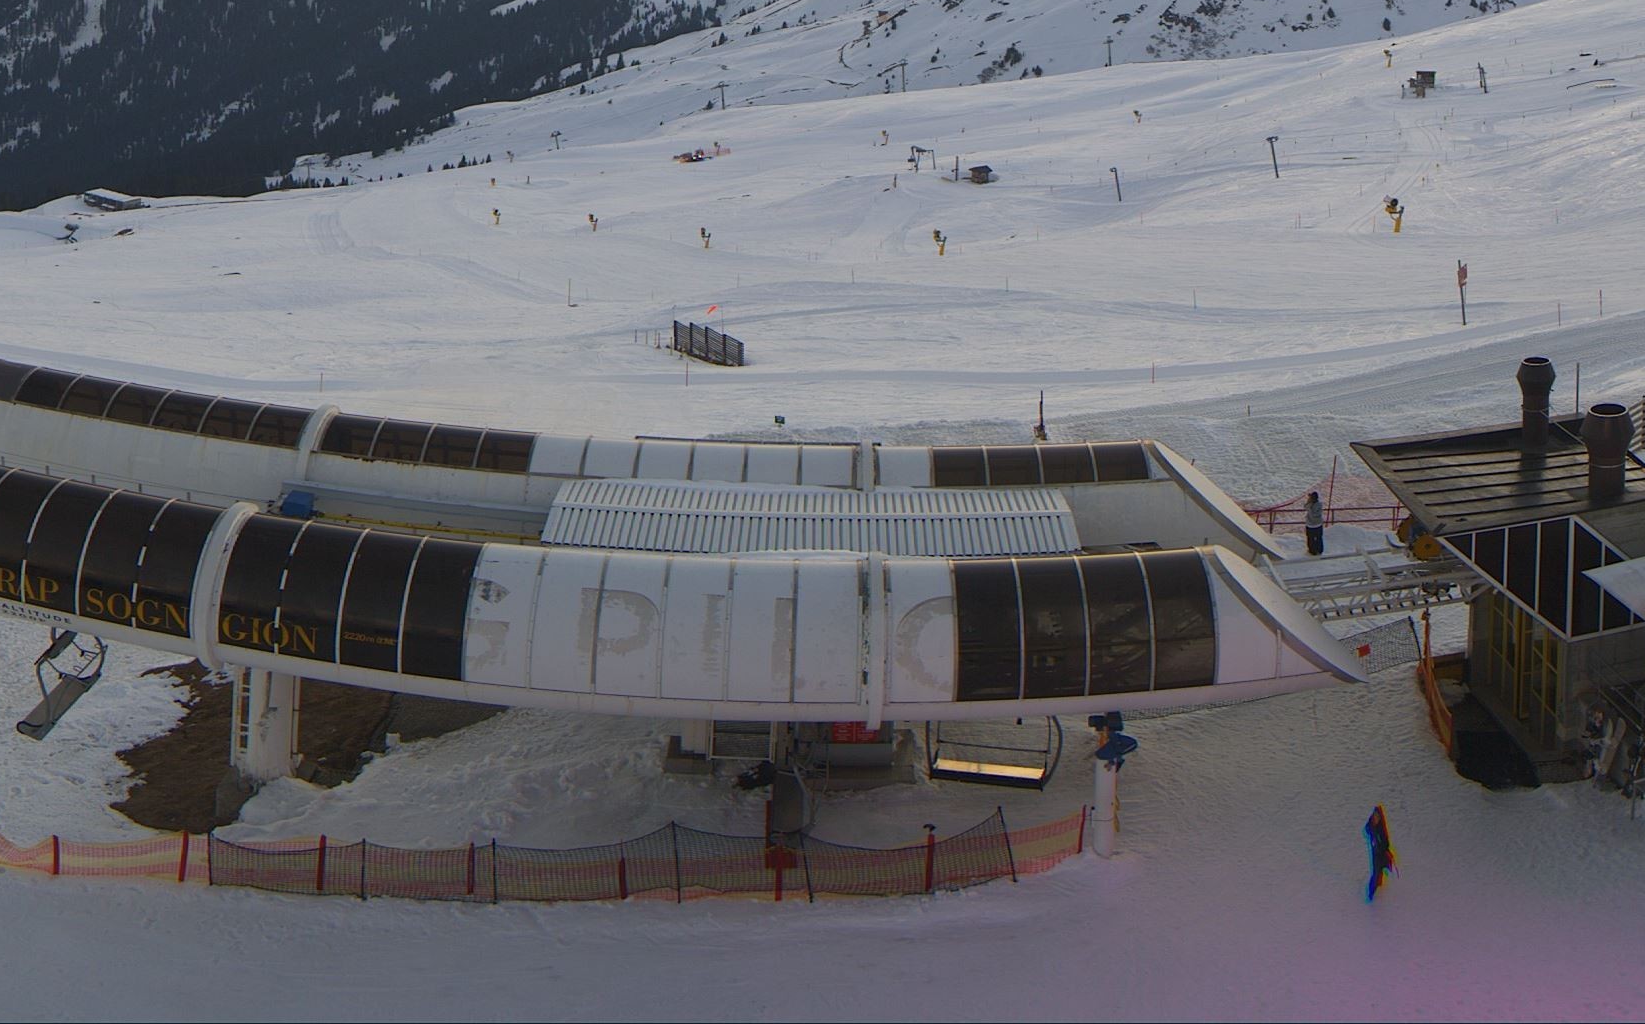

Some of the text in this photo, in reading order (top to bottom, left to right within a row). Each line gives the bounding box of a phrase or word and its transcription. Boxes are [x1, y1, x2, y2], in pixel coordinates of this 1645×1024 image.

[1, 603, 72, 625] ALTITUDE
[84, 587, 190, 632] SOGN
[221, 612, 319, 654] GION
